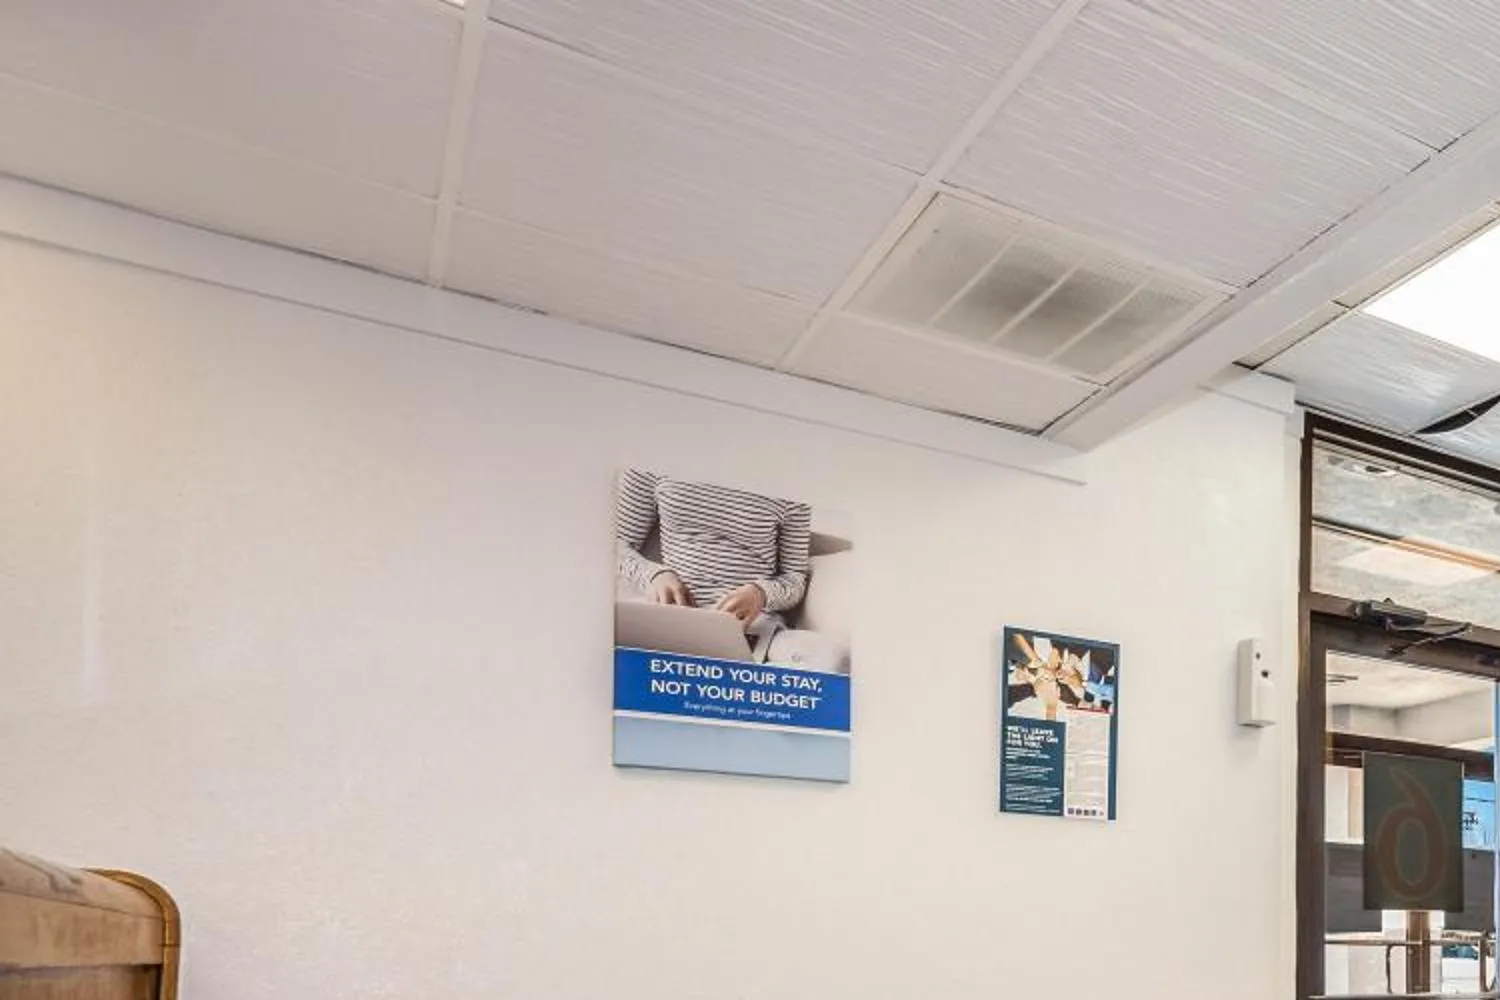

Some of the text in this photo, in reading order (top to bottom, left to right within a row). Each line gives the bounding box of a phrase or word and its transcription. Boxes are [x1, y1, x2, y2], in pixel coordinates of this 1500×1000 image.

[650, 659, 823, 693] EXTEND YOUR STAY,
[650, 679, 823, 710] NOT YOUR BUDGET
